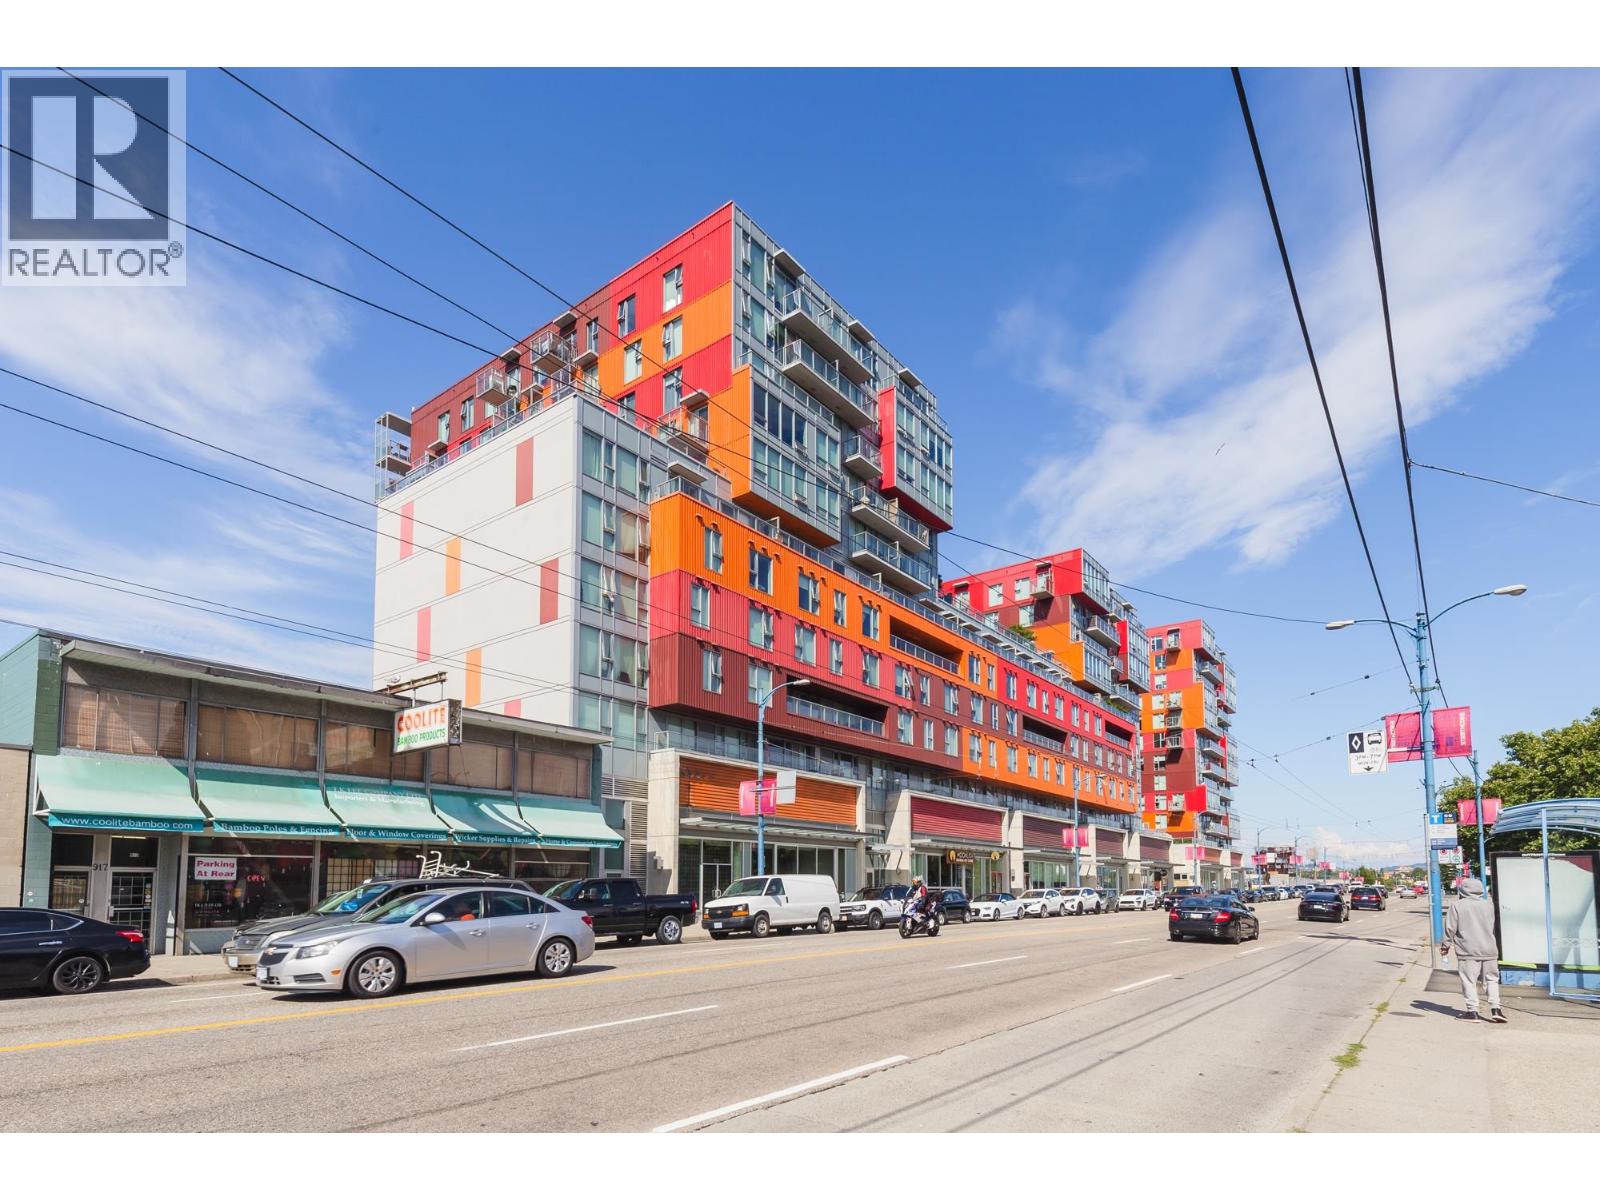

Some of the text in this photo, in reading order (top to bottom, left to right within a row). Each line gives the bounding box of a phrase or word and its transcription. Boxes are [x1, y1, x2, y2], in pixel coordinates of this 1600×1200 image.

[397, 704, 446, 733] COOLITE
[397, 728, 446, 746] BAMBOO PRODUCTS
[220, 823, 261, 832] Bamboo
[263, 824, 288, 833] Poles
[378, 830, 408, 838] Window
[410, 831, 447, 840] Coverings
[92, 863, 108, 871] 917
[197, 860, 235, 868] Parking
